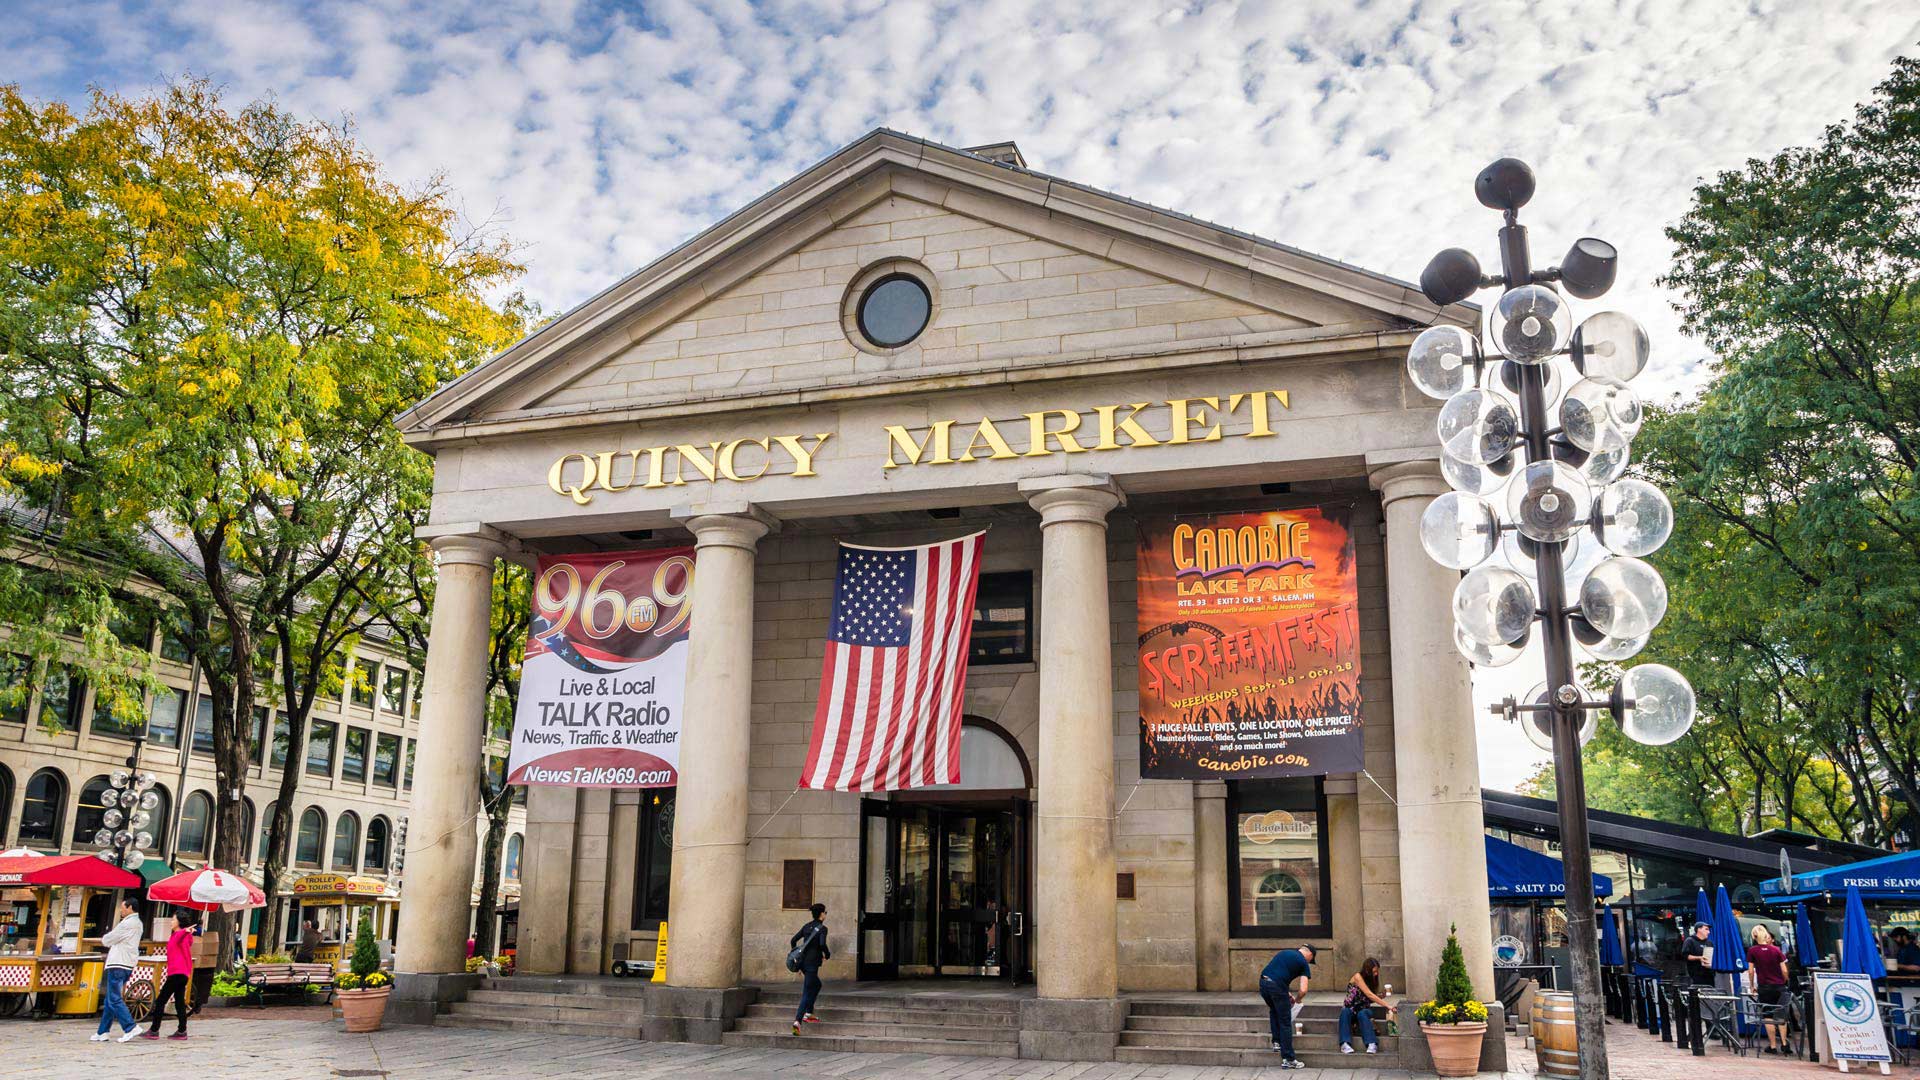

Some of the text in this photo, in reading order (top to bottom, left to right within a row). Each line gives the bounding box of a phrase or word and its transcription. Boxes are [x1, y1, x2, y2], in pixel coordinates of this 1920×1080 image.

[548, 390, 1290, 505] QUINCY MARKET
[1173, 522, 1312, 575] CANOBIE
[1177, 573, 1316, 597] LAKE PARK
[1178, 600, 1195, 608] RTE.
[1217, 597, 1233, 605] EXIT
[1242, 596, 1255, 604] OR
[1272, 593, 1302, 602] SALEM,
[631, 604, 655, 624] FM
[1222, 606, 1238, 614] north
[559, 676, 655, 696] Live & Local
[1244, 682, 1276, 694] Sept.
[1279, 676, 1295, 686] 28
[1308, 669, 1333, 679] Oct.
[1337, 662, 1353, 673] 28
[538, 700, 670, 727] TALK Radio
[1150, 715, 1352, 732] 3 HUGE FALL EVENTS, ONE LOCATION, ONE PRICE!
[522, 729, 678, 747] News, Traffic & Weather
[1157, 734, 1186, 742] Haunted
[1188, 734, 1214, 742] Houses,
[1215, 733, 1236, 741] Rides,
[1237, 732, 1262, 741] Games,
[1279, 730, 1303, 739] Shows,
[1304, 727, 1346, 737] Oktoberfest
[1219, 743, 1233, 751] and
[1244, 742, 1263, 750] much
[1264, 741, 1286, 749] more!
[1198, 753, 1310, 771] canobie.com
[523, 765, 671, 784] NewsTalk969.com
[1254, 822, 1310, 834] Bagelville
[1515, 884, 1565, 893] SALTY DO
[1843, 878, 1878, 887] FRESH
